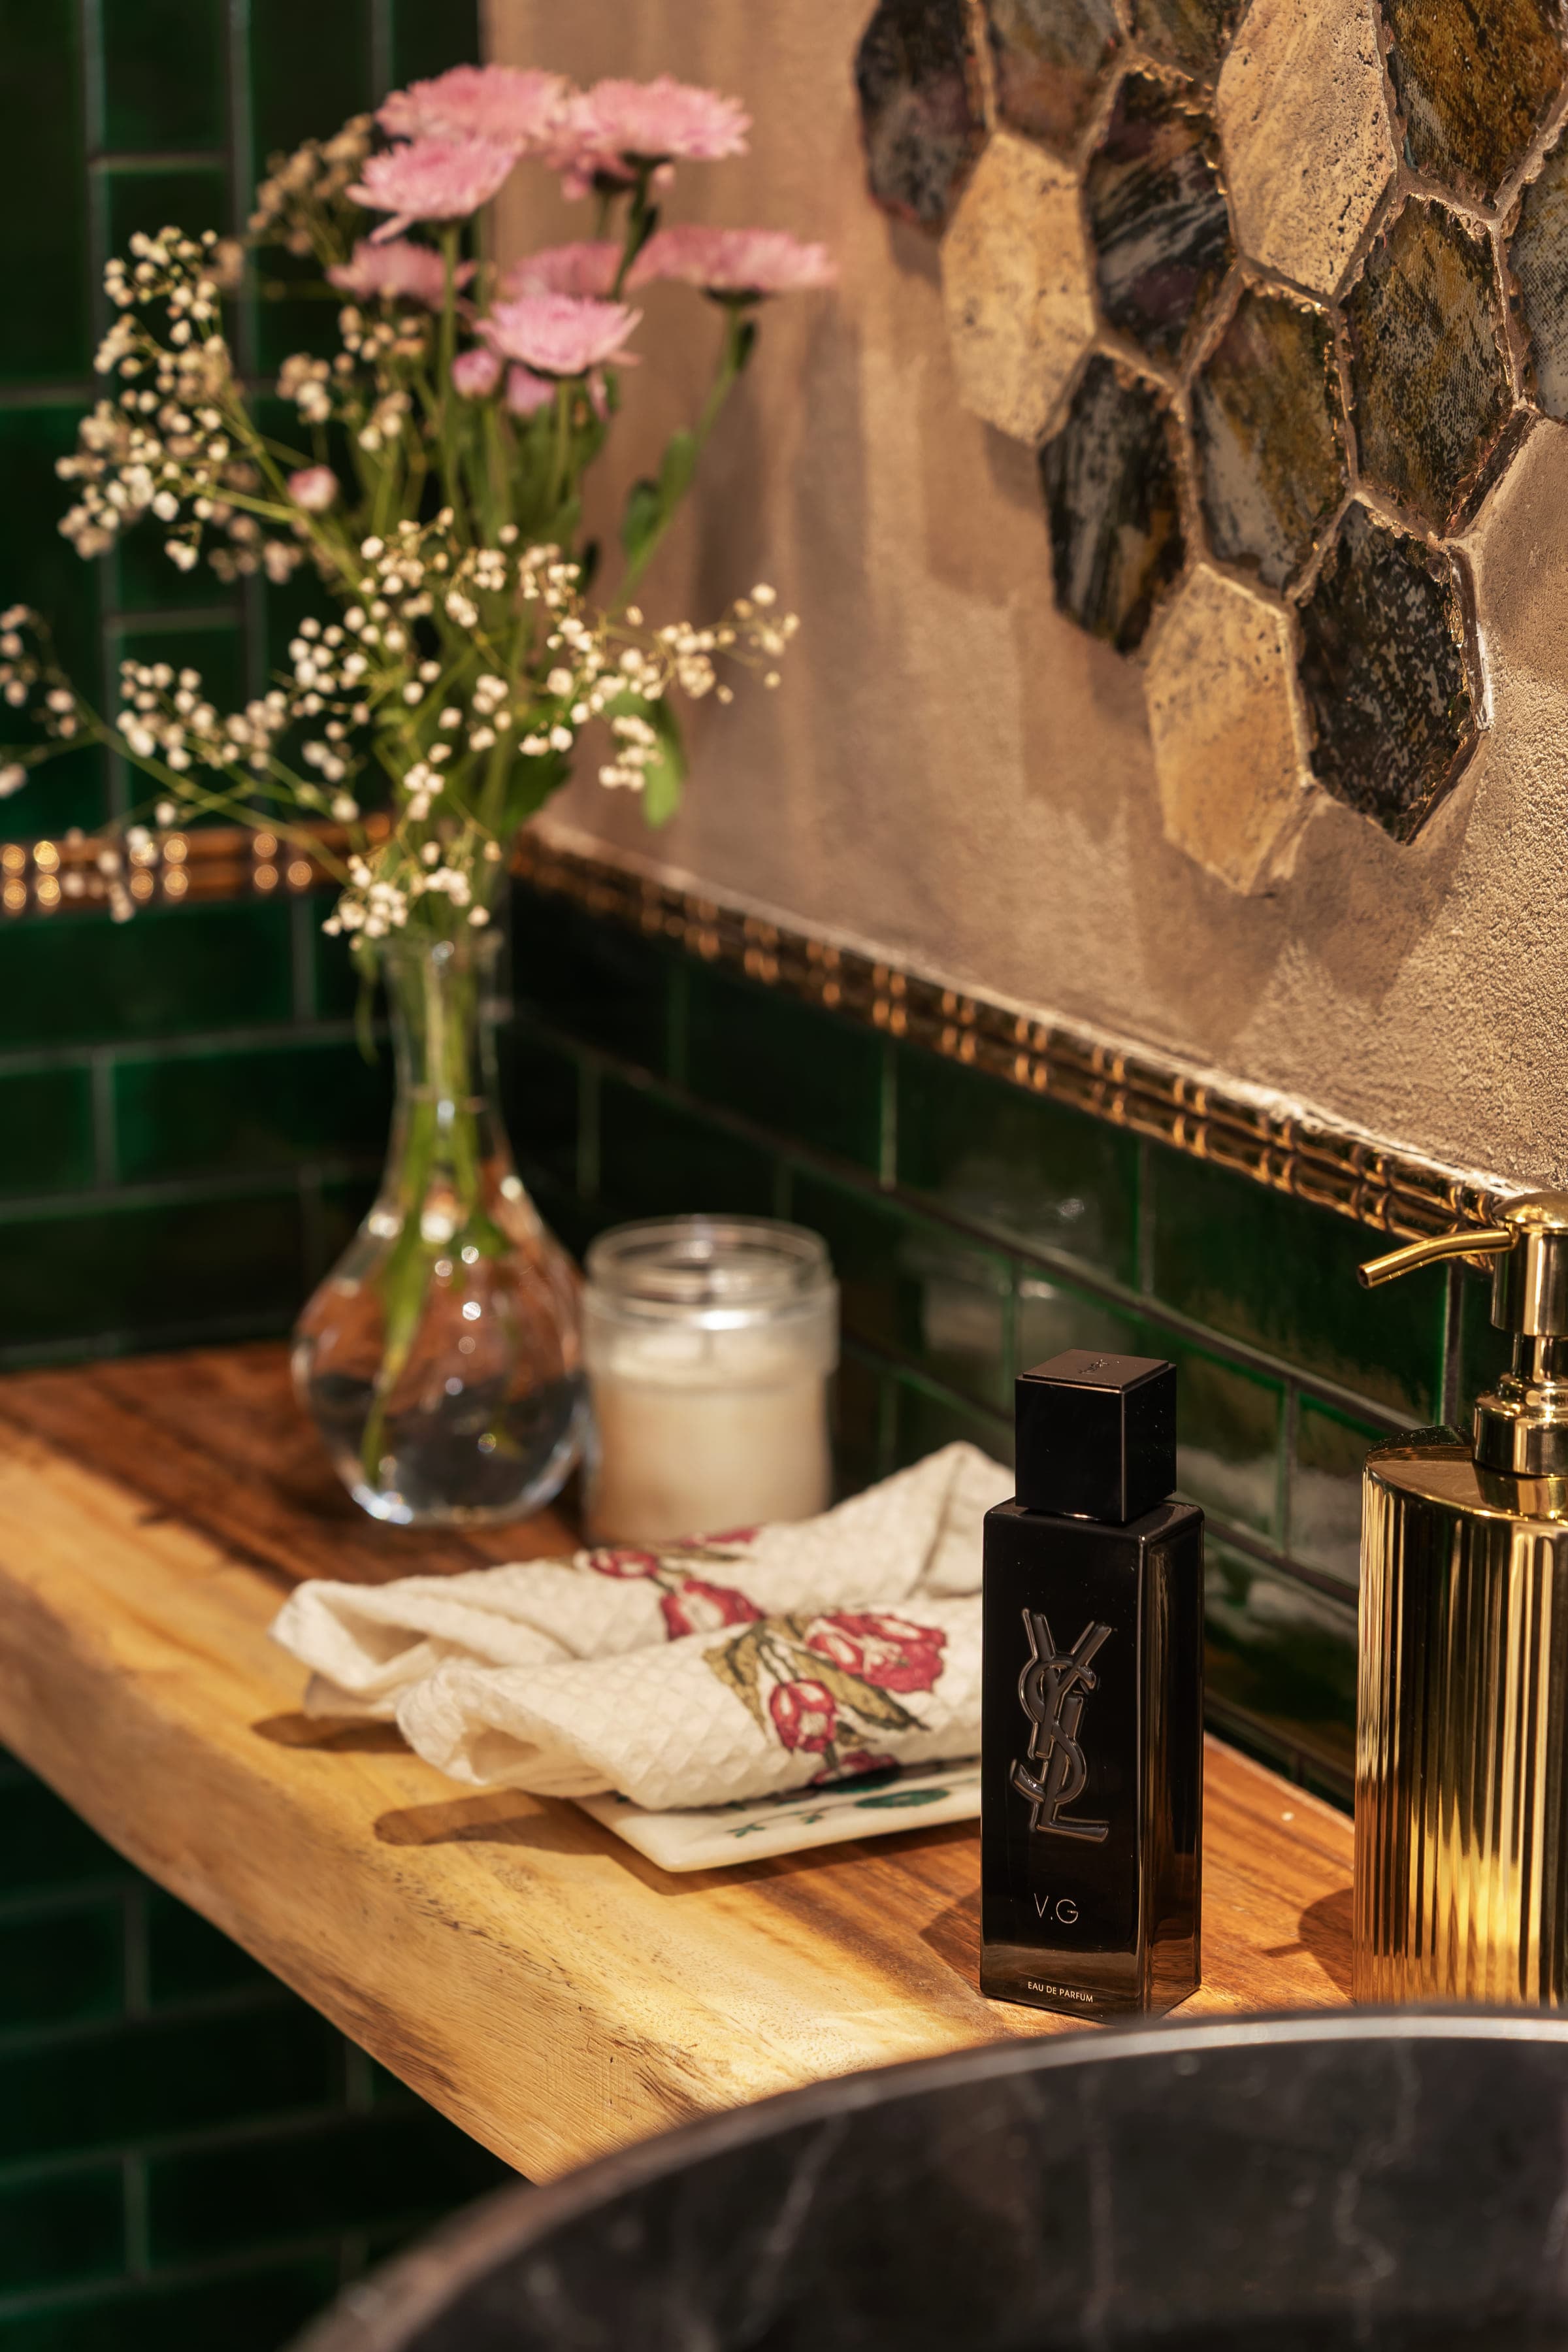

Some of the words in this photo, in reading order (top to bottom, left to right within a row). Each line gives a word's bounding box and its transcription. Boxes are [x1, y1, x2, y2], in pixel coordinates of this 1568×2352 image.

[1034, 1893, 1078, 1923] V.G
[1028, 1981, 1044, 1992] EAU
[1046, 1985, 1056, 1995] DE
[1060, 1988, 1093, 2002] PARFUM
